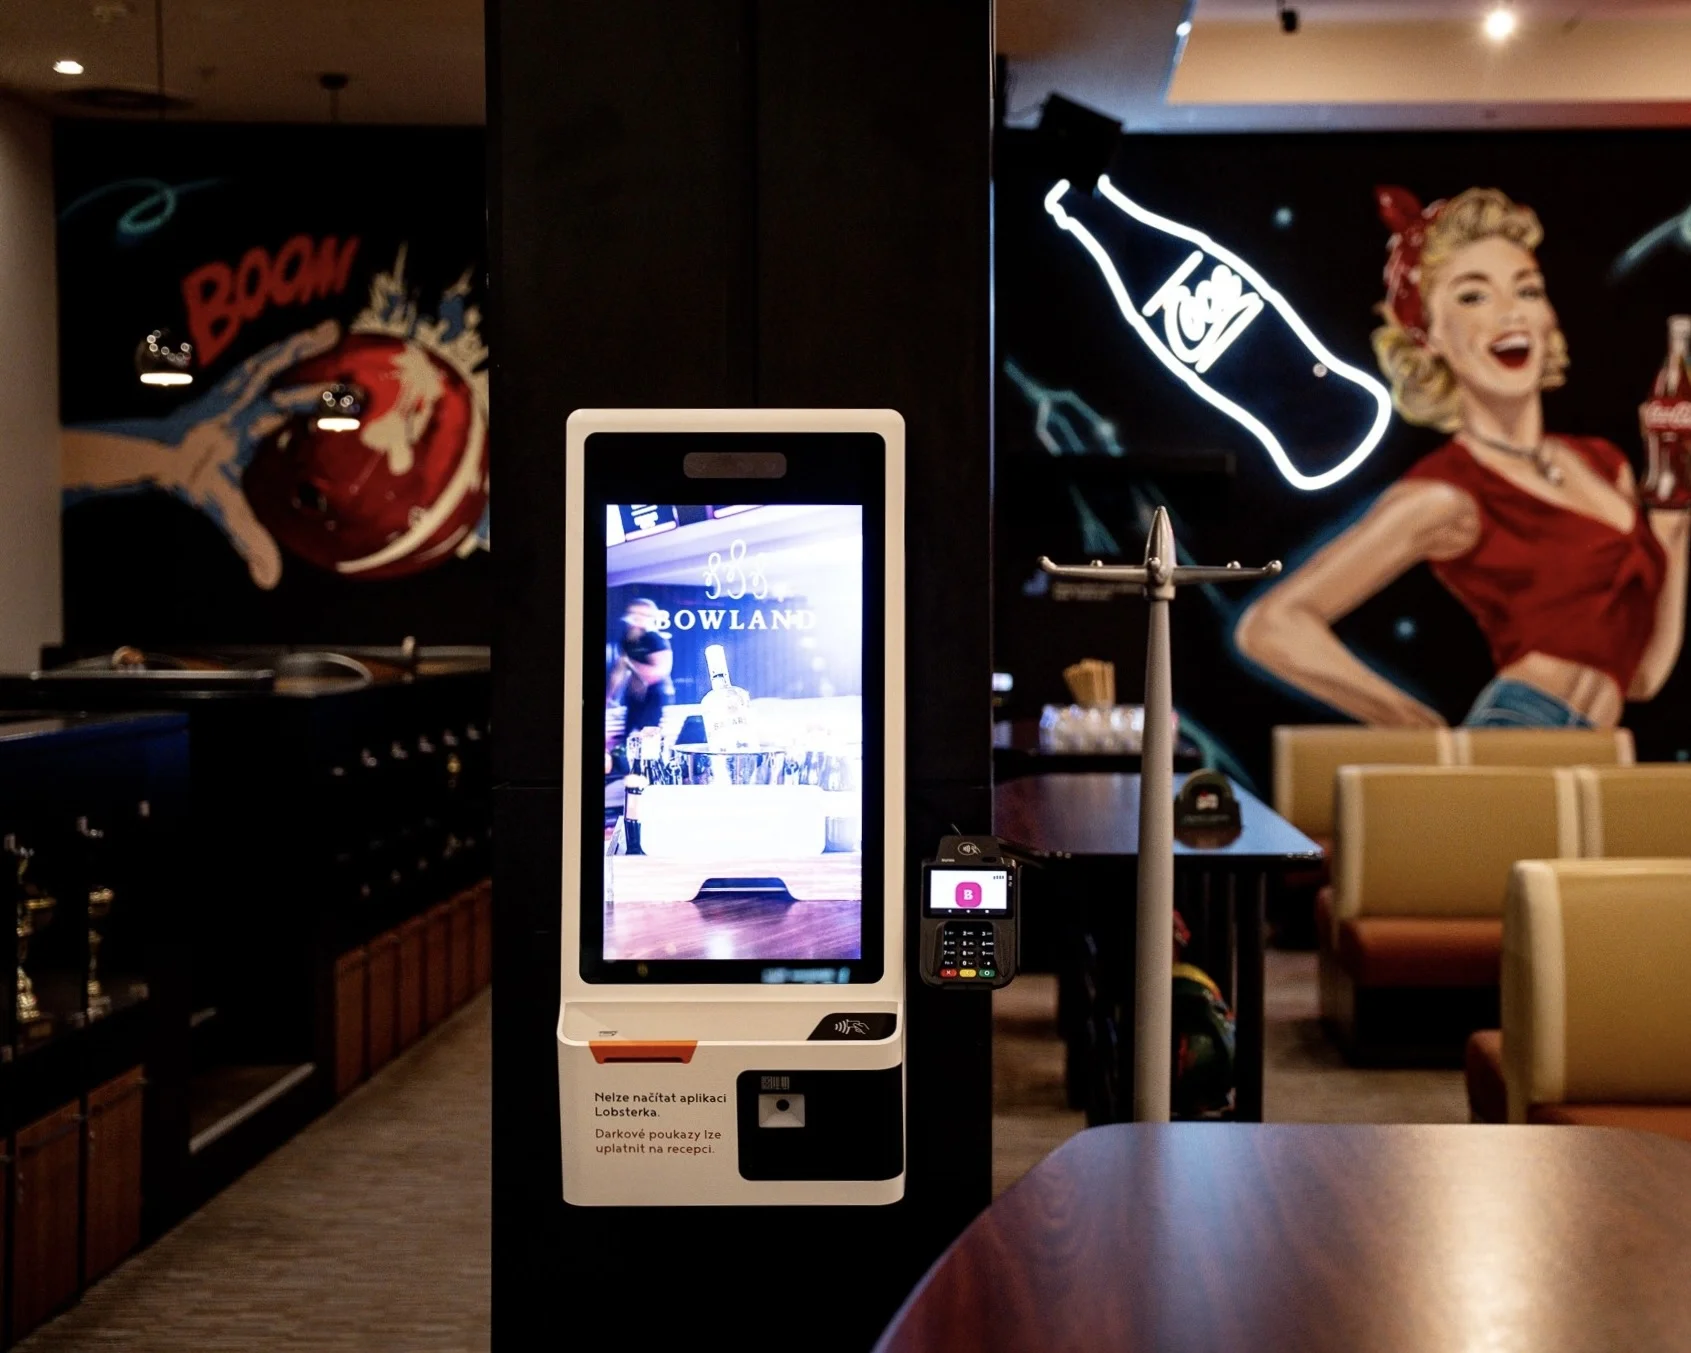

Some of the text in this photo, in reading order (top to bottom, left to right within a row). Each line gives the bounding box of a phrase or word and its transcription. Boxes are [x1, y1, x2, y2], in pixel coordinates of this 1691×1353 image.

[180, 234, 360, 367] BOOM
[654, 609, 817, 631] BOWLAND
[963, 889, 974, 900] B
[594, 1092, 727, 1105] Nelze načítat aplikaci
[594, 1106, 660, 1117] Lobsterka.
[595, 1128, 722, 1141] Darkové poukazy lze
[595, 1143, 715, 1156] uplatnit na recepci.
